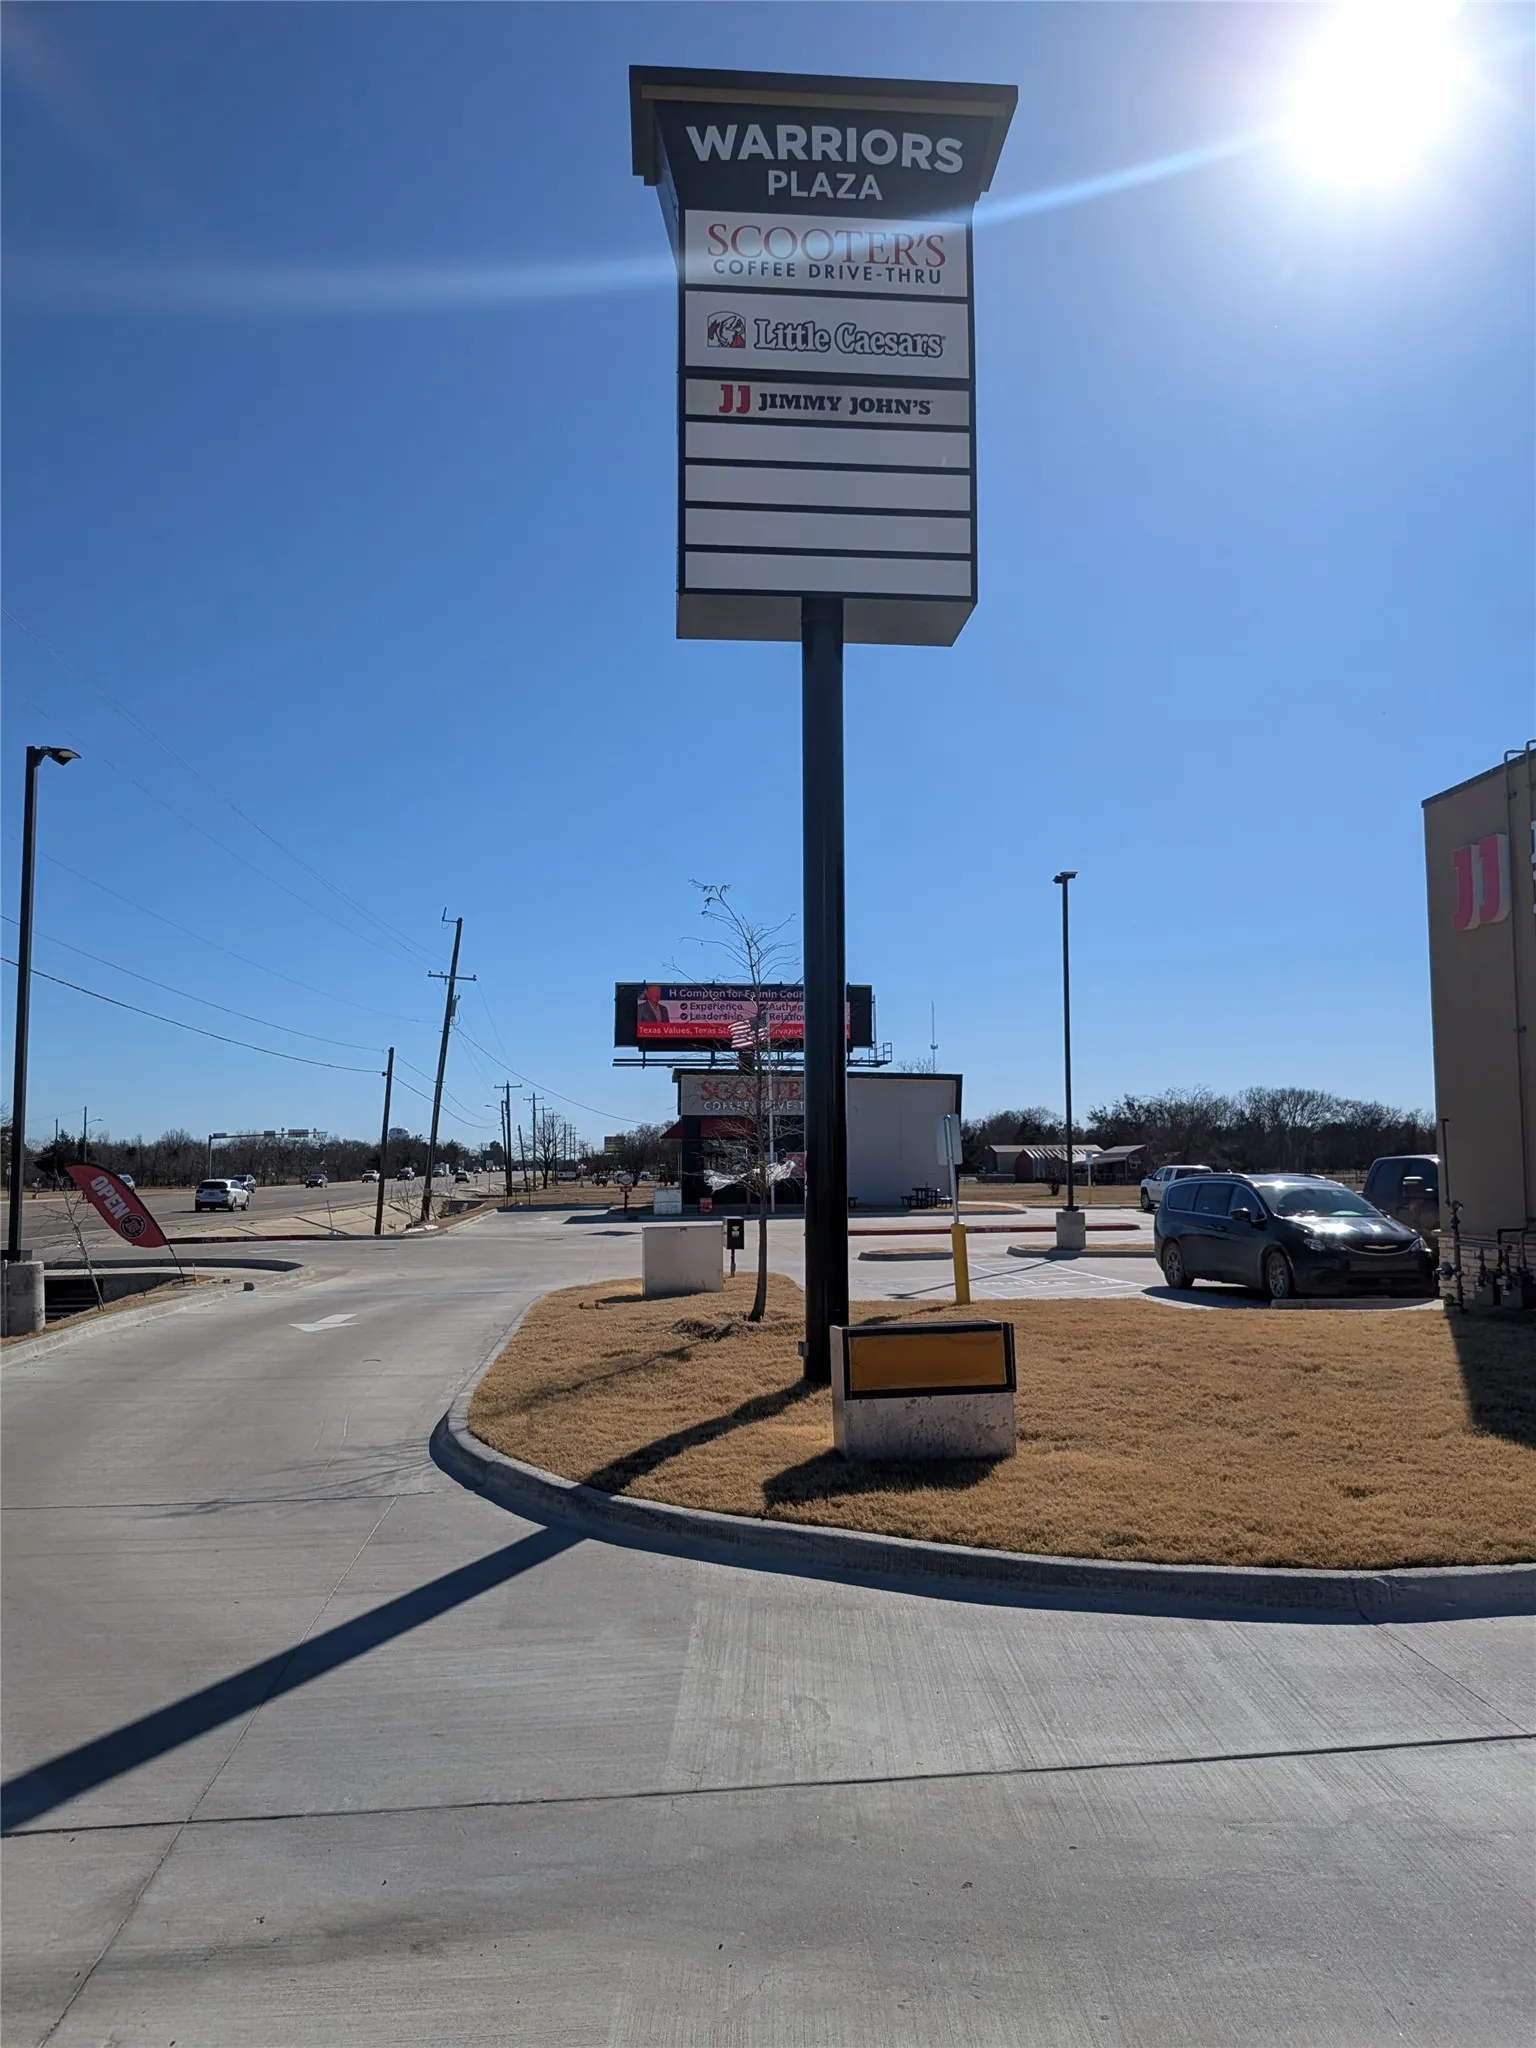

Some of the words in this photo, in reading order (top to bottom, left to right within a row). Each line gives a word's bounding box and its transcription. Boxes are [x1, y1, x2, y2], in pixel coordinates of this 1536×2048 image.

[686, 124, 963, 174] WARRIORS
[768, 170, 883, 200] PLAZA
[707, 223, 946, 268] SCOOTER'S
[713, 259, 796, 277] COFFEE
[808, 264, 941, 284] DRIVE-THRU
[753, 318, 830, 352] Little
[834, 322, 943, 358] Caesars
[719, 384, 751, 414] JJ
[759, 393, 842, 412] JIMMY
[848, 396, 931, 415] JOHN'S
[1451, 833, 1508, 931] JJ
[680, 988, 726, 1000] Compton
[728, 988, 741, 998] for
[744, 989, 777, 998] Fanin
[690, 1002, 743, 1012] Experience
[769, 1002, 804, 1011] Authen
[640, 1026, 661, 1034] Texas
[663, 1026, 693, 1035] Values,
[694, 1026, 716, 1034] Texas
[690, 1012, 743, 1022] Leadership
[769, 1013, 804, 1021] Relatio
[91, 1175, 131, 1219] OPEN
